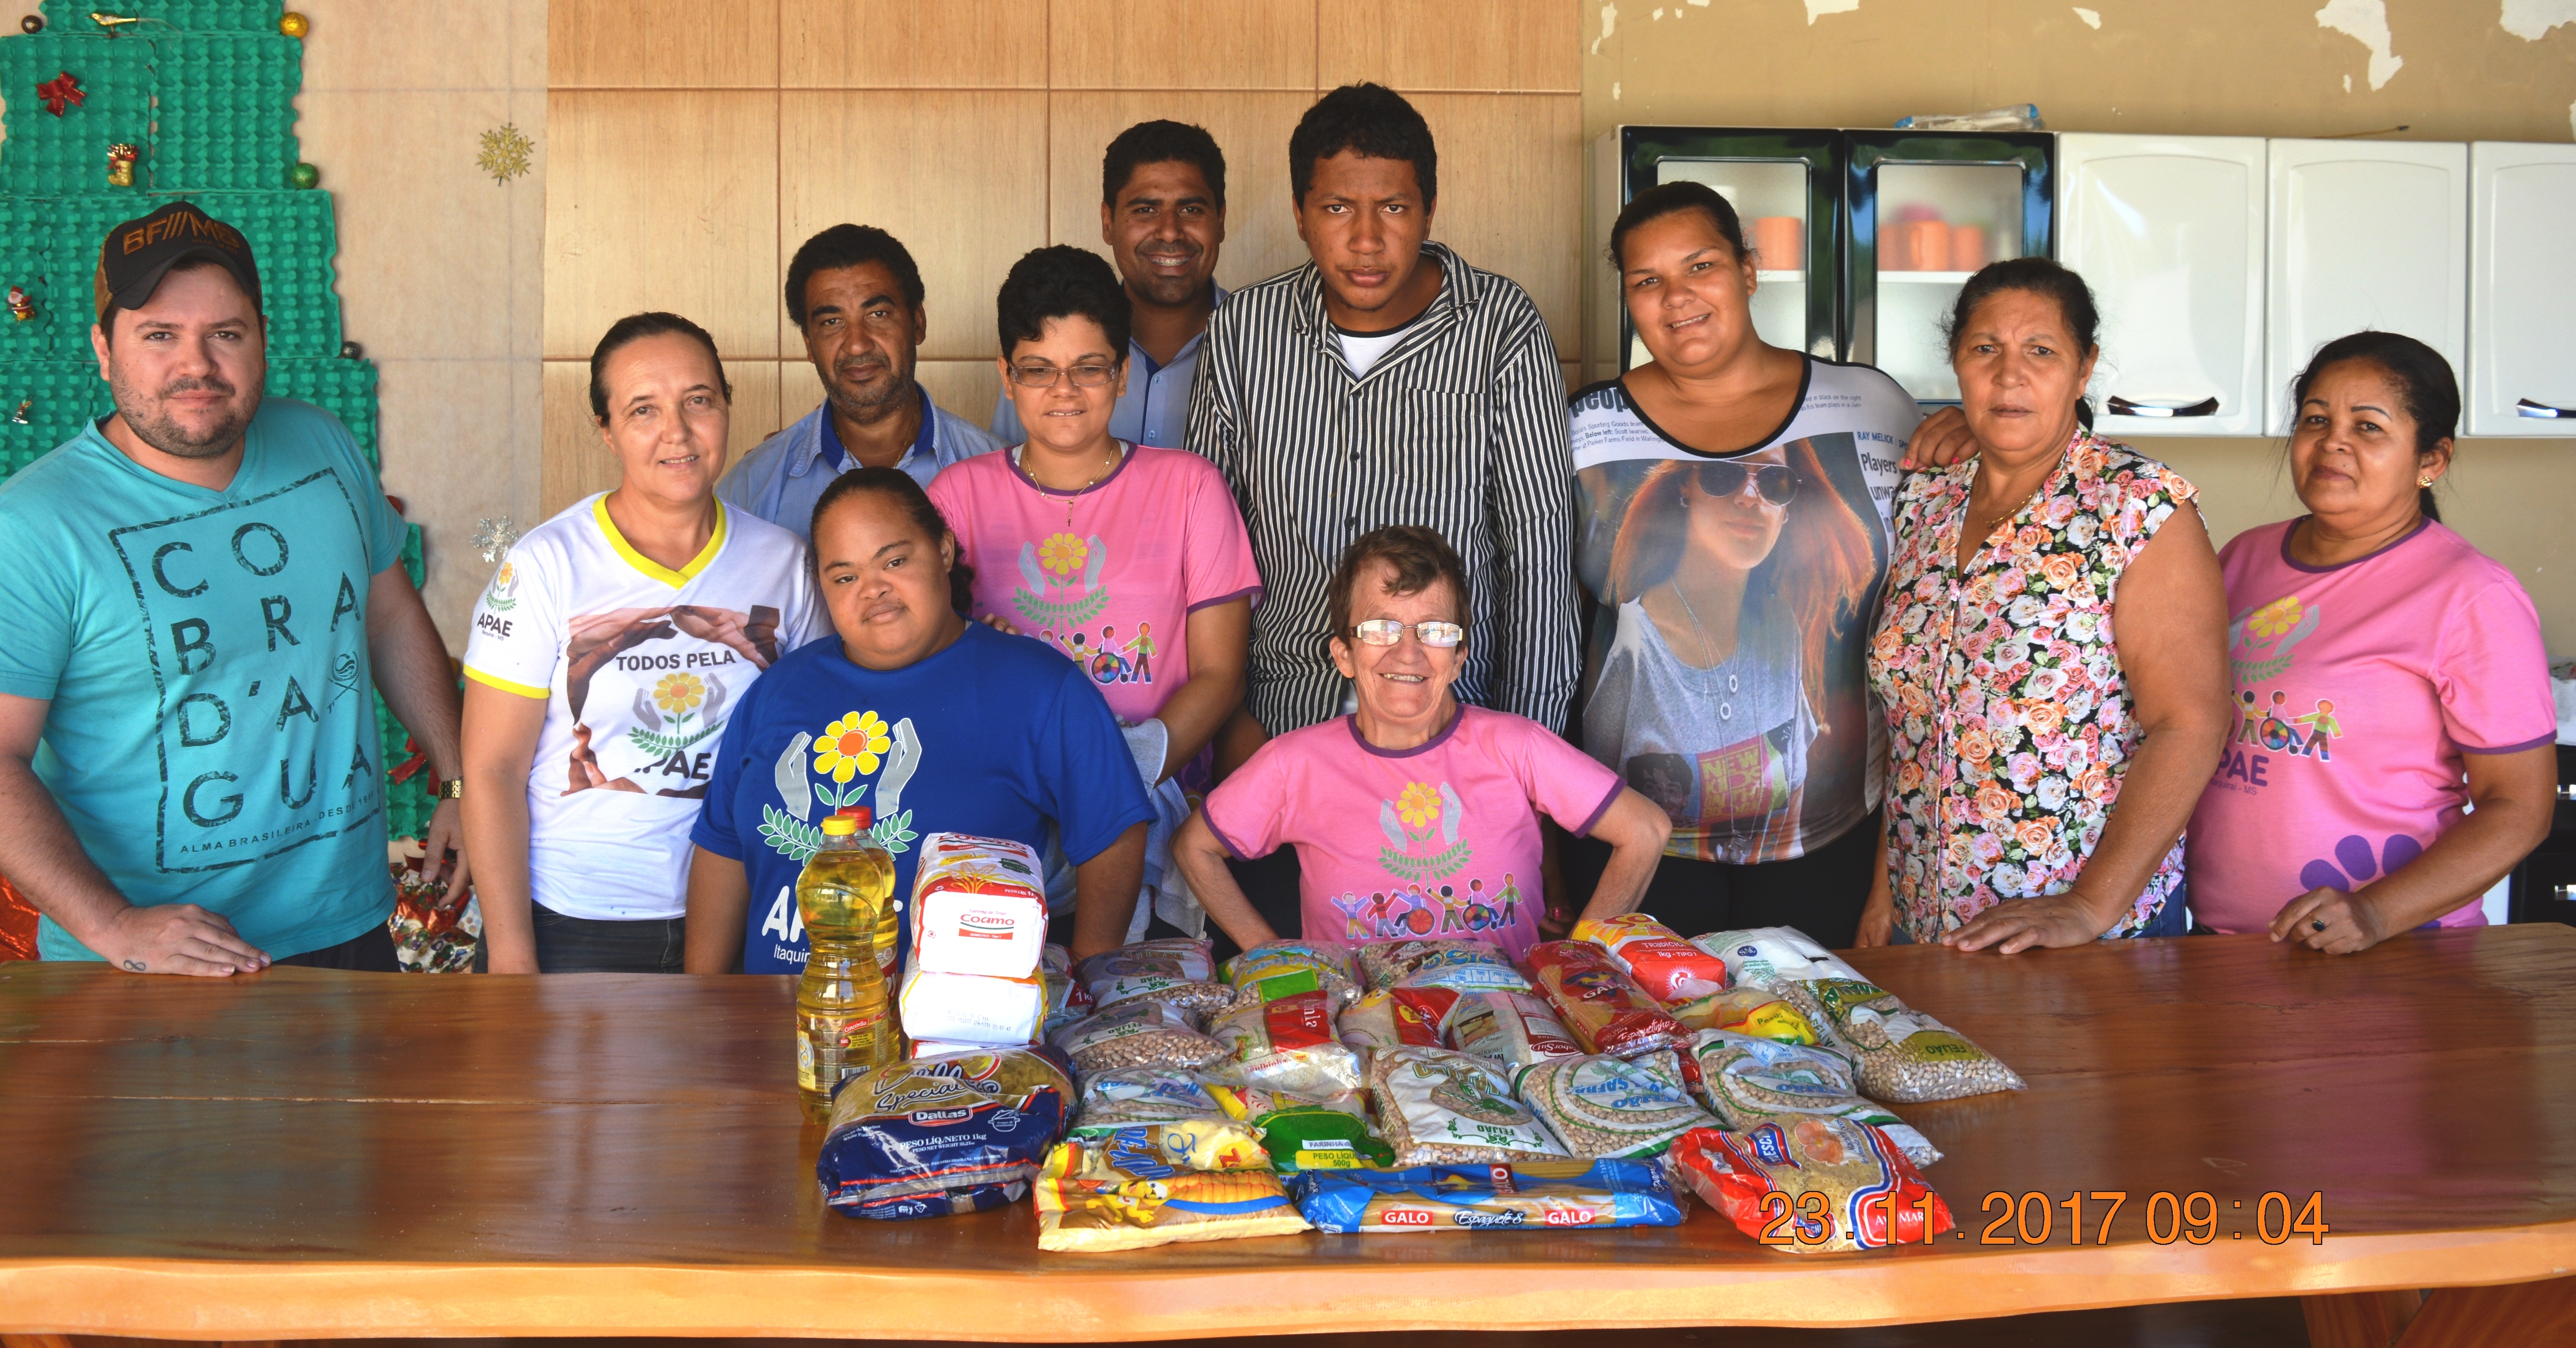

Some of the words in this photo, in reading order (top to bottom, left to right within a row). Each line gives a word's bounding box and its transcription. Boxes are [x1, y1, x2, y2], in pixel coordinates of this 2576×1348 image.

[1571, 388, 1630, 418] peop
[1588, 421, 1610, 430] Sporting
[1586, 430, 1601, 438] Below
[1857, 431, 1869, 441] RAY
[1872, 432, 1893, 444] MELICK
[1899, 439, 1908, 449] SPO
[1861, 452, 1896, 476] Players
[477, 612, 513, 638] APAE
[616, 653, 681, 672] TODOS
[686, 649, 737, 669] PELA
[2215, 747, 2269, 787] PAE
[2244, 785, 2257, 795] MS
[180, 841, 223, 853] ALMA
[229, 819, 311, 848] BRASILEIRA
[319, 801, 356, 819] DESDE
[960, 914, 1015, 925] Coamo
[774, 943, 811, 965] Itaquir
[1583, 983, 1630, 998] GALO
[844, 1021, 867, 1033] Concórdia
[1617, 1019, 1670, 1041] Espaguetinho
[1926, 1042, 1967, 1056] FEIJÃO
[916, 1109, 967, 1121] Dallas
[900, 1139, 924, 1150] PESO
[972, 1133, 987, 1141] 1kg
[1333, 1159, 1351, 1168] 500g
[1492, 1167, 1514, 1194] GALO
[1385, 1211, 1429, 1224] GALO
[1454, 1210, 1512, 1226] Espaguete
[1513, 1211, 1522, 1223] 8
[1548, 1211, 1592, 1224] GALO
[1899, 1211, 1924, 1223] MAR
